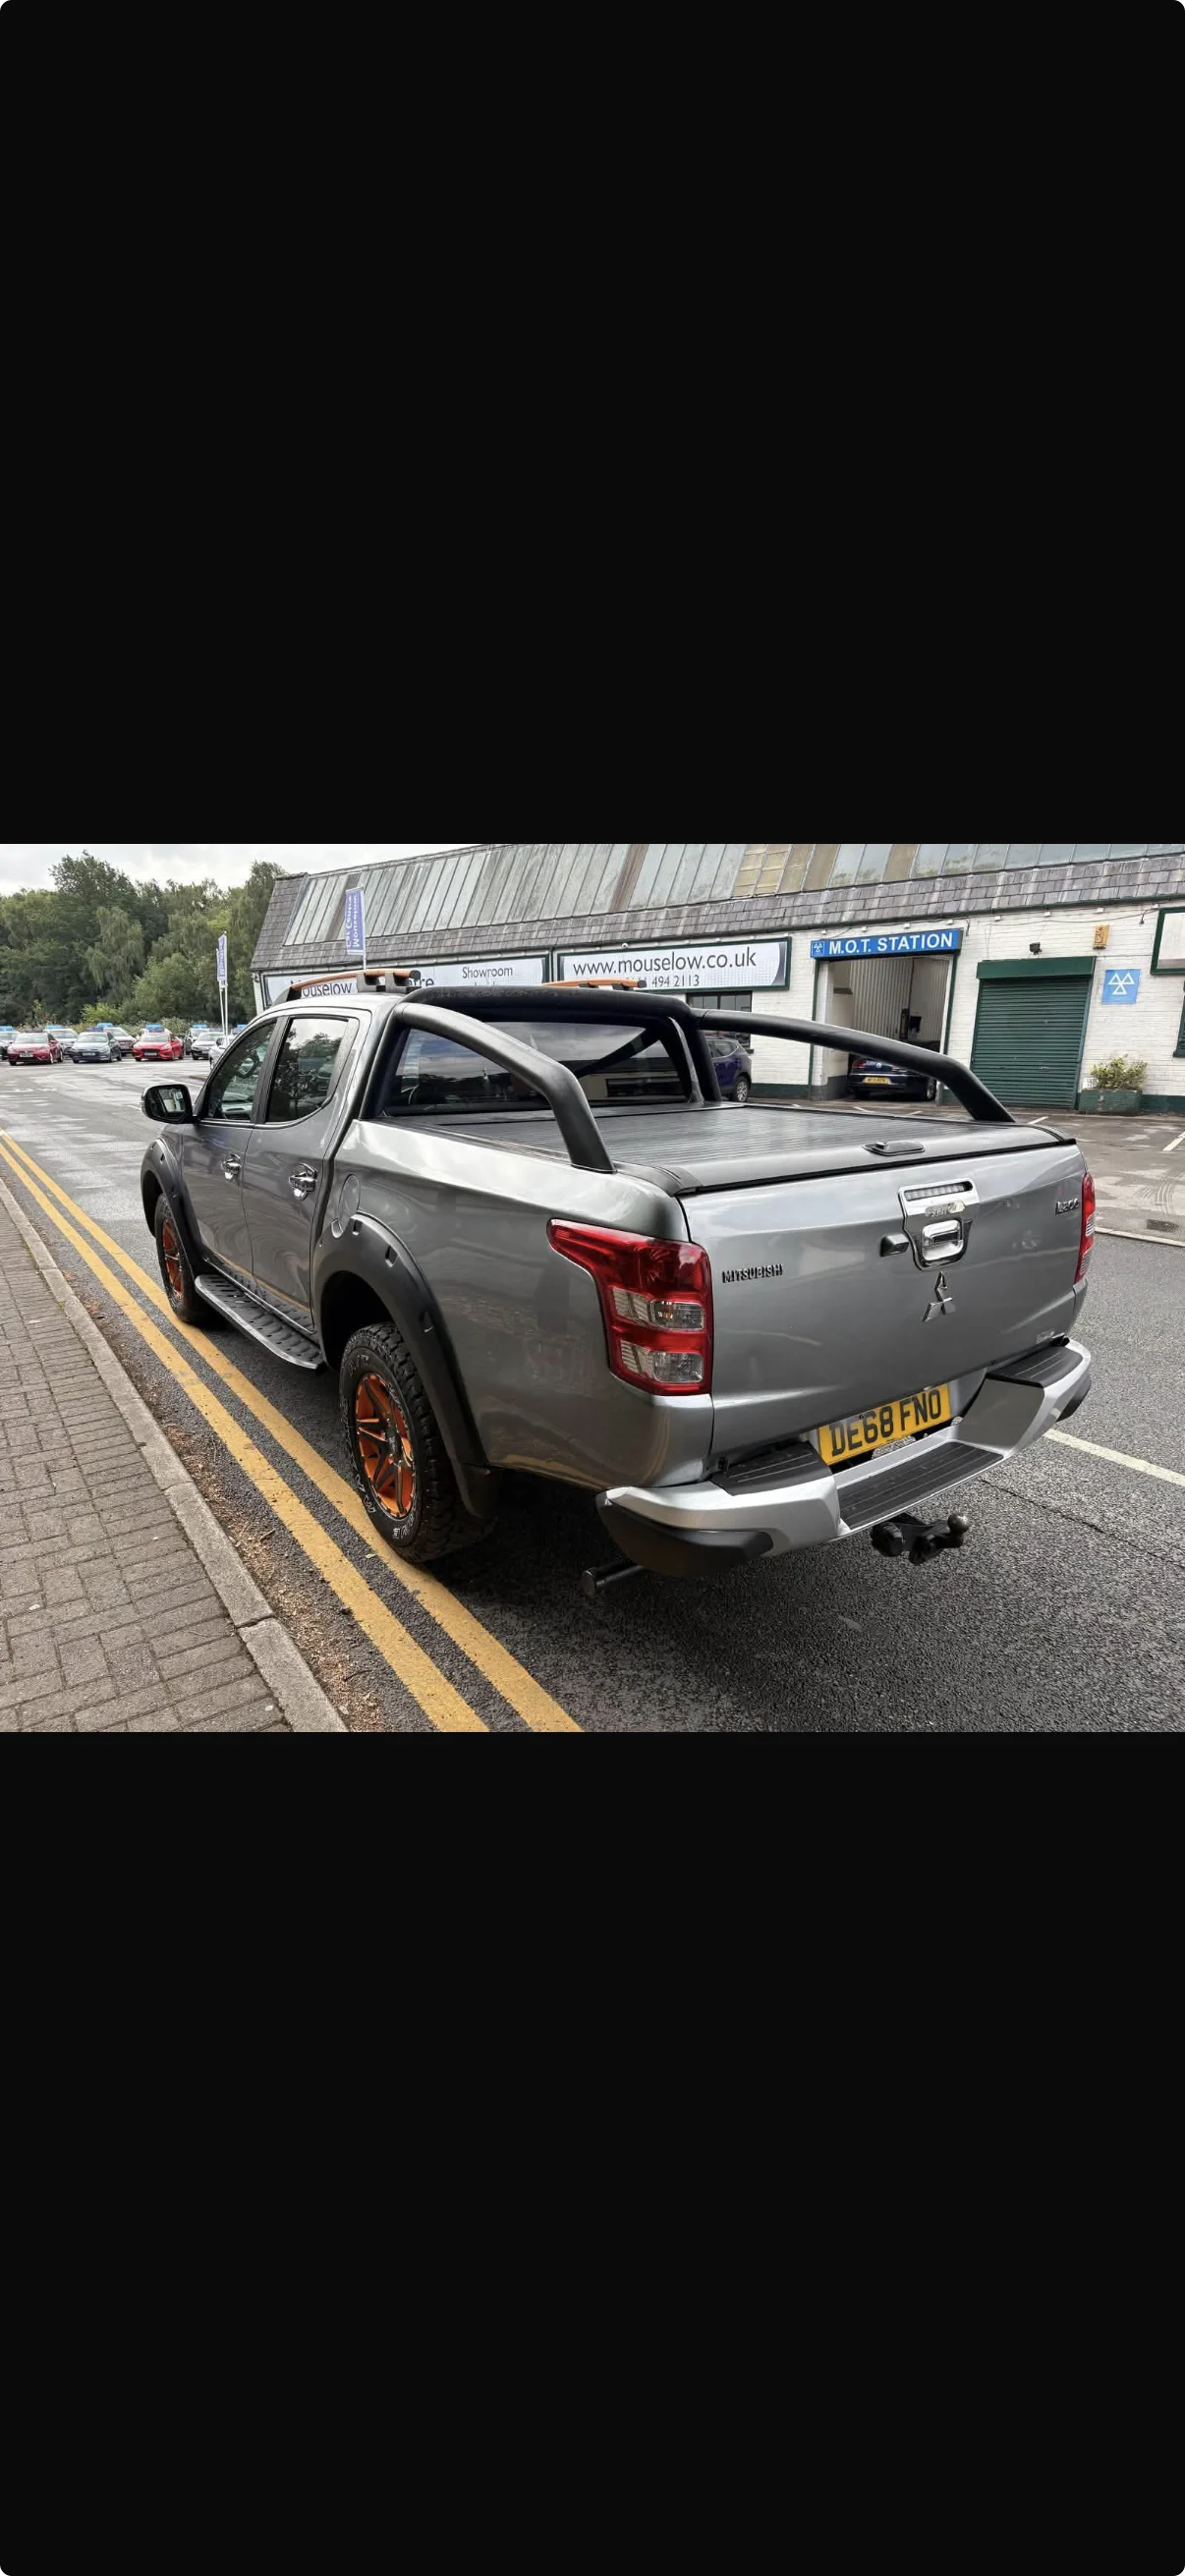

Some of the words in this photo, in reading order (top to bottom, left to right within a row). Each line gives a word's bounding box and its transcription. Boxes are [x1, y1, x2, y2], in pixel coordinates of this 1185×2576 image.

[828, 938, 872, 955] M.O.T.
[877, 932, 952, 951] STATION
[573, 946, 757, 976] www.mouselow.co.uk
[462, 966, 513, 979] Showroom
[651, 975, 669, 987] 494
[673, 974, 700, 987] 2113
[291, 980, 353, 997] ouselow
[722, 1264, 783, 1283] MITSUBISHI
[828, 1405, 894, 1457] DE68
[899, 1388, 941, 1431] FNO
